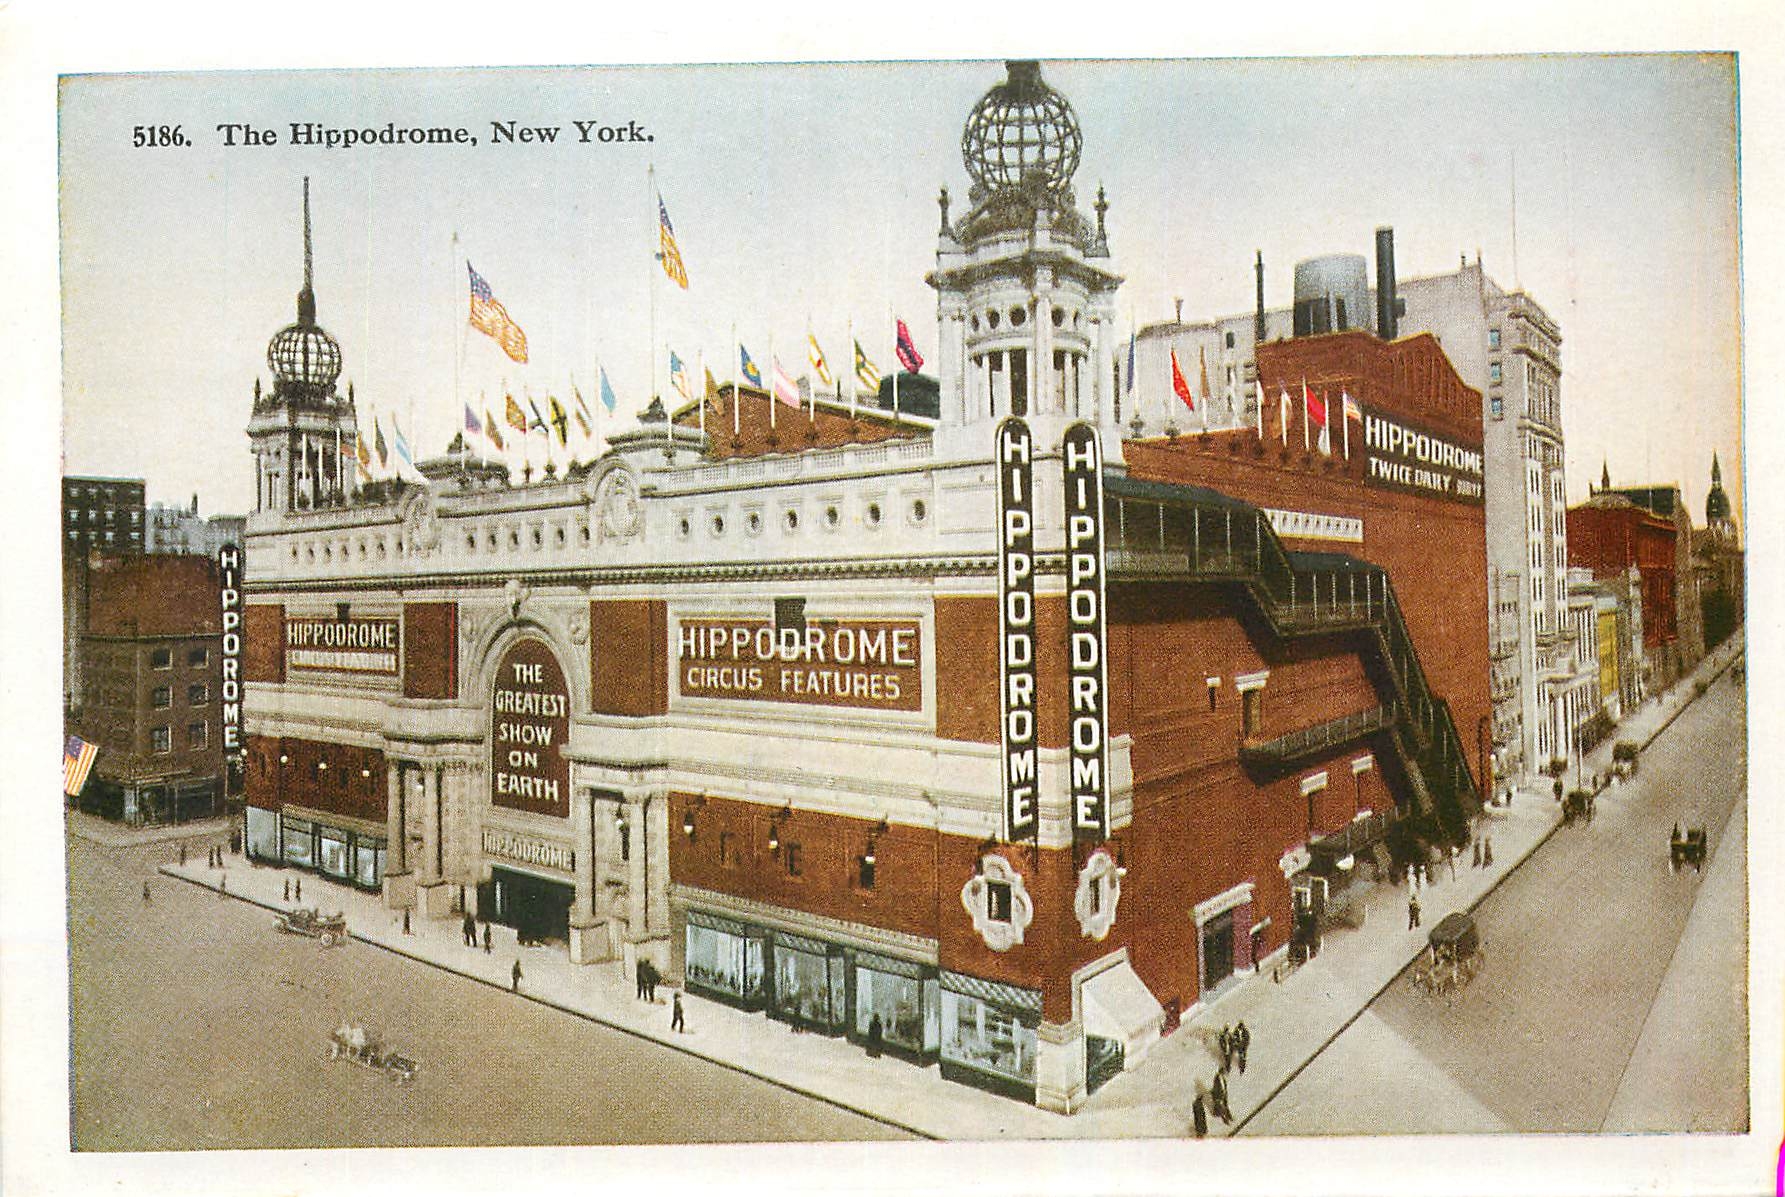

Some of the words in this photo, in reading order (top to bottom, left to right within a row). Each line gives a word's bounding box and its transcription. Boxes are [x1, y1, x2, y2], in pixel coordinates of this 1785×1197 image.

[1365, 415, 1483, 475] HIPPODROME
[287, 622, 397, 648] HIPPODROME
[1002, 432, 1034, 827] HIPPODROME
[1066, 441, 1100, 830] HIPPODROME
[678, 627, 916, 666] HIPPODROME
[513, 663, 543, 683] THE
[687, 667, 763, 690] CIRCUS
[781, 670, 901, 700] FEATURES
[496, 690, 567, 717] GREATEST
[499, 723, 552, 746] SHOW
[508, 750, 538, 768] ON
[497, 772, 559, 801] EARTH
